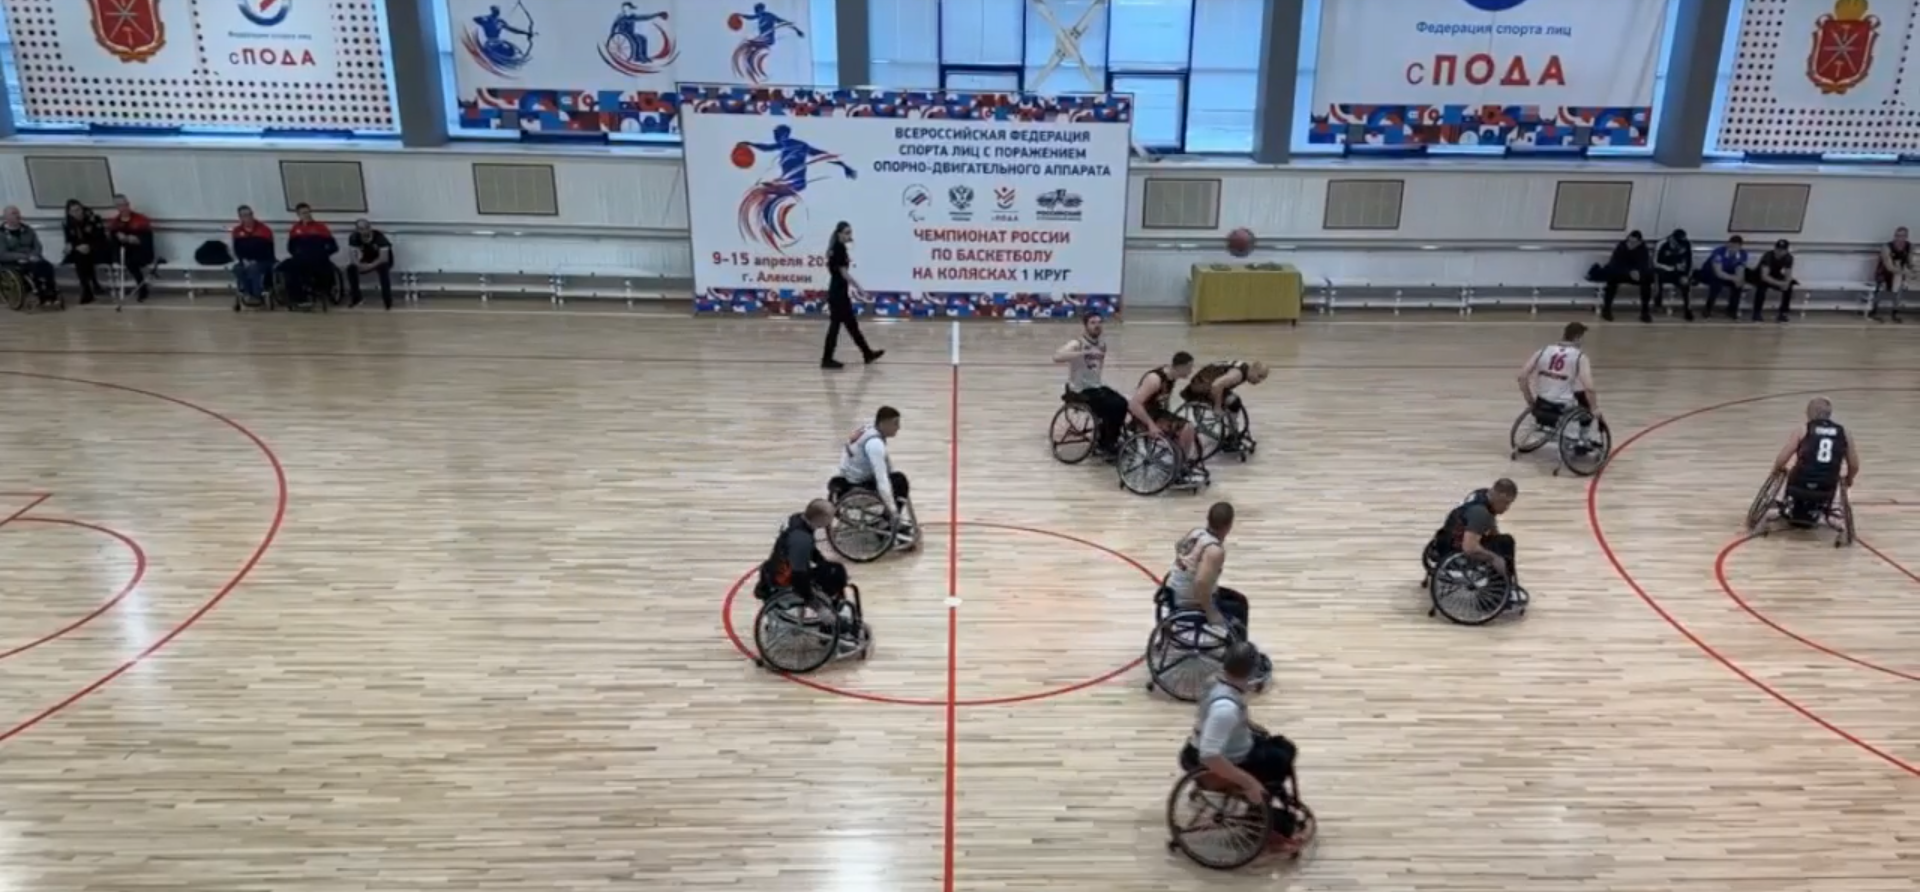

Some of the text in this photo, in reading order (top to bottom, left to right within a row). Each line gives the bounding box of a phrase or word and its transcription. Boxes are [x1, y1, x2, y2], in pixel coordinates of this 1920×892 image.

[1416, 21, 1572, 37] Федерация спорта лиц
[895, 127, 1090, 143] ВСЕРОССИЙСКАЯ ФЕДЕРАЦИЯ
[899, 145, 1086, 159] СПОРТА ЛИЦ С ПОРАЖЕНИЕМ
[873, 161, 1111, 176] ОПОРНО-ДВИГАТЕЛЬНОГО АППАРАТА
[914, 229, 1070, 244] ЧЕМПИОНАТ РОССИИ
[712, 252, 750, 266] 9-15
[754, 256, 803, 269] апреля
[931, 248, 1053, 263] ПО БАСКЕТБОЛУ
[742, 272, 812, 283] г. Алексин
[912, 267, 1071, 281] НА КОЛЯСКАХ 1 КРУГ
[1549, 353, 1566, 371] 16
[1817, 438, 1833, 463] 8
